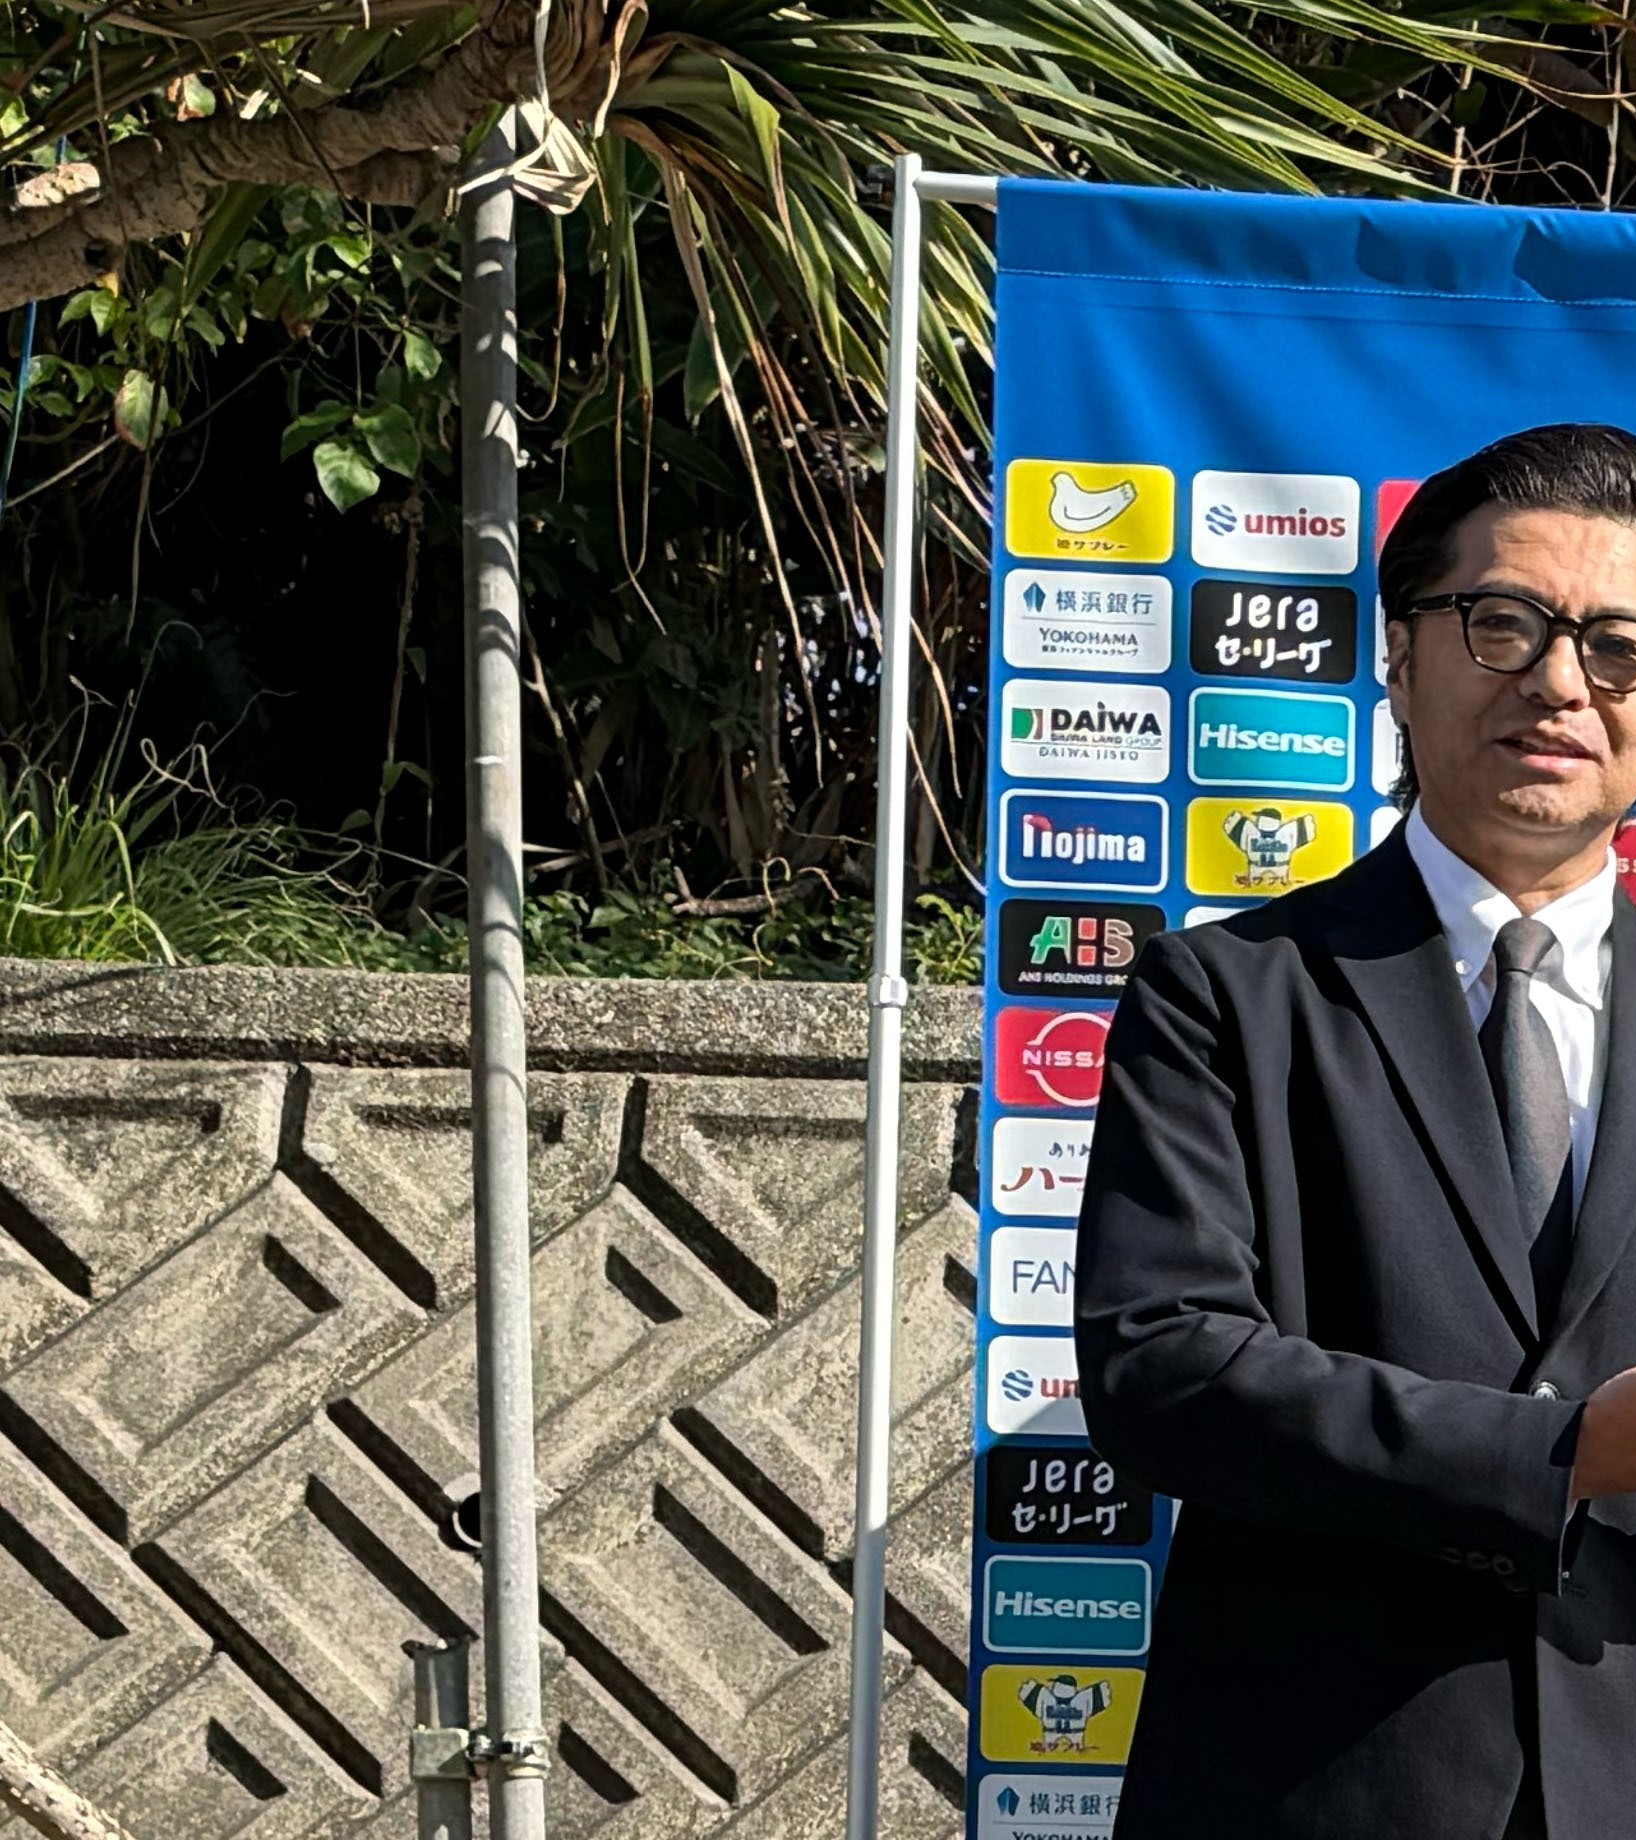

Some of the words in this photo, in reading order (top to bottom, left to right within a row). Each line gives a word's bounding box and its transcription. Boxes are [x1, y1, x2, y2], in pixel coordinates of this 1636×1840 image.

[1245, 508, 1346, 538] umios
[1056, 589, 1154, 616] 横浜銀行
[1039, 627, 1138, 647] YOKOHAMA
[1199, 722, 1346, 757] Hisense
[1023, 1049, 1106, 1068] NISS
[1000, 1167, 1084, 1193] ハー
[995, 1591, 1142, 1619] Hisense
